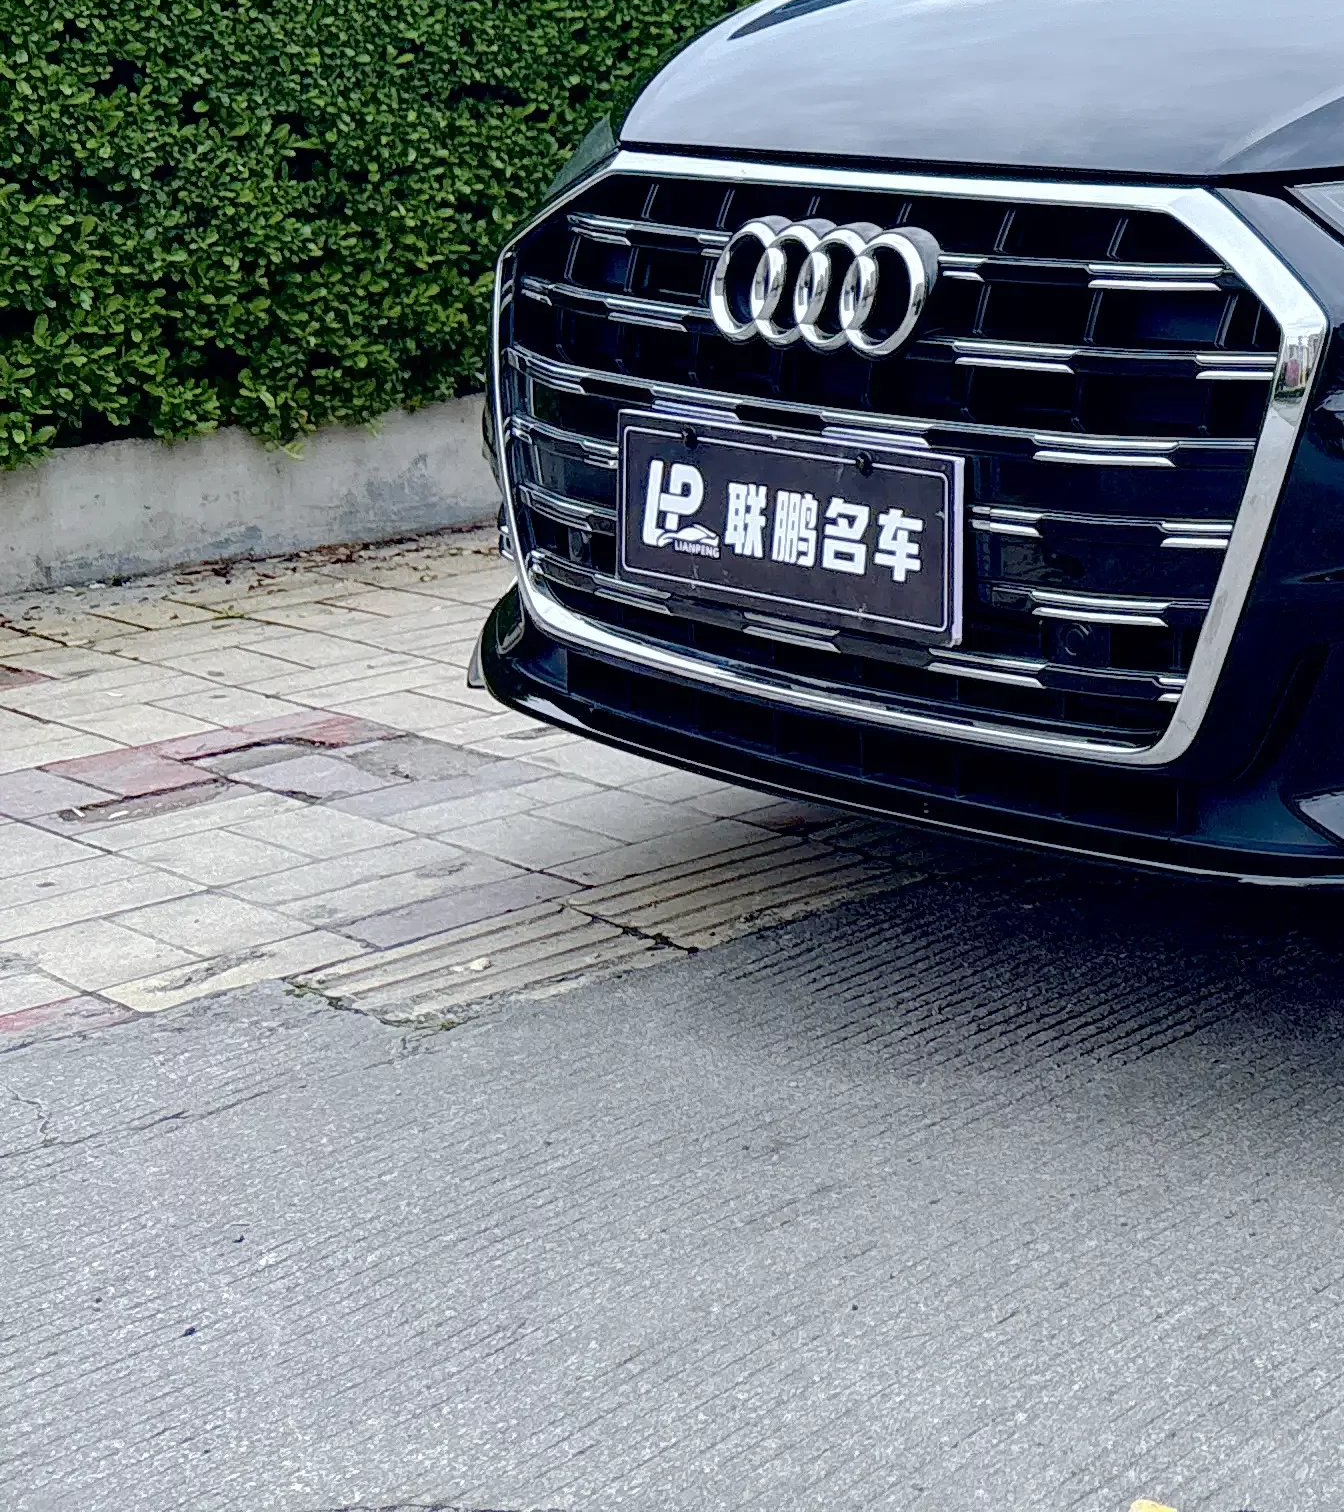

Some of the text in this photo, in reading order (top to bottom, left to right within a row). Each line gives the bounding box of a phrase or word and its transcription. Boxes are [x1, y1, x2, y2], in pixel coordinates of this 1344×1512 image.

[674, 539, 720, 559] LIANPENG
[724, 480, 925, 583] 联鹏名车
